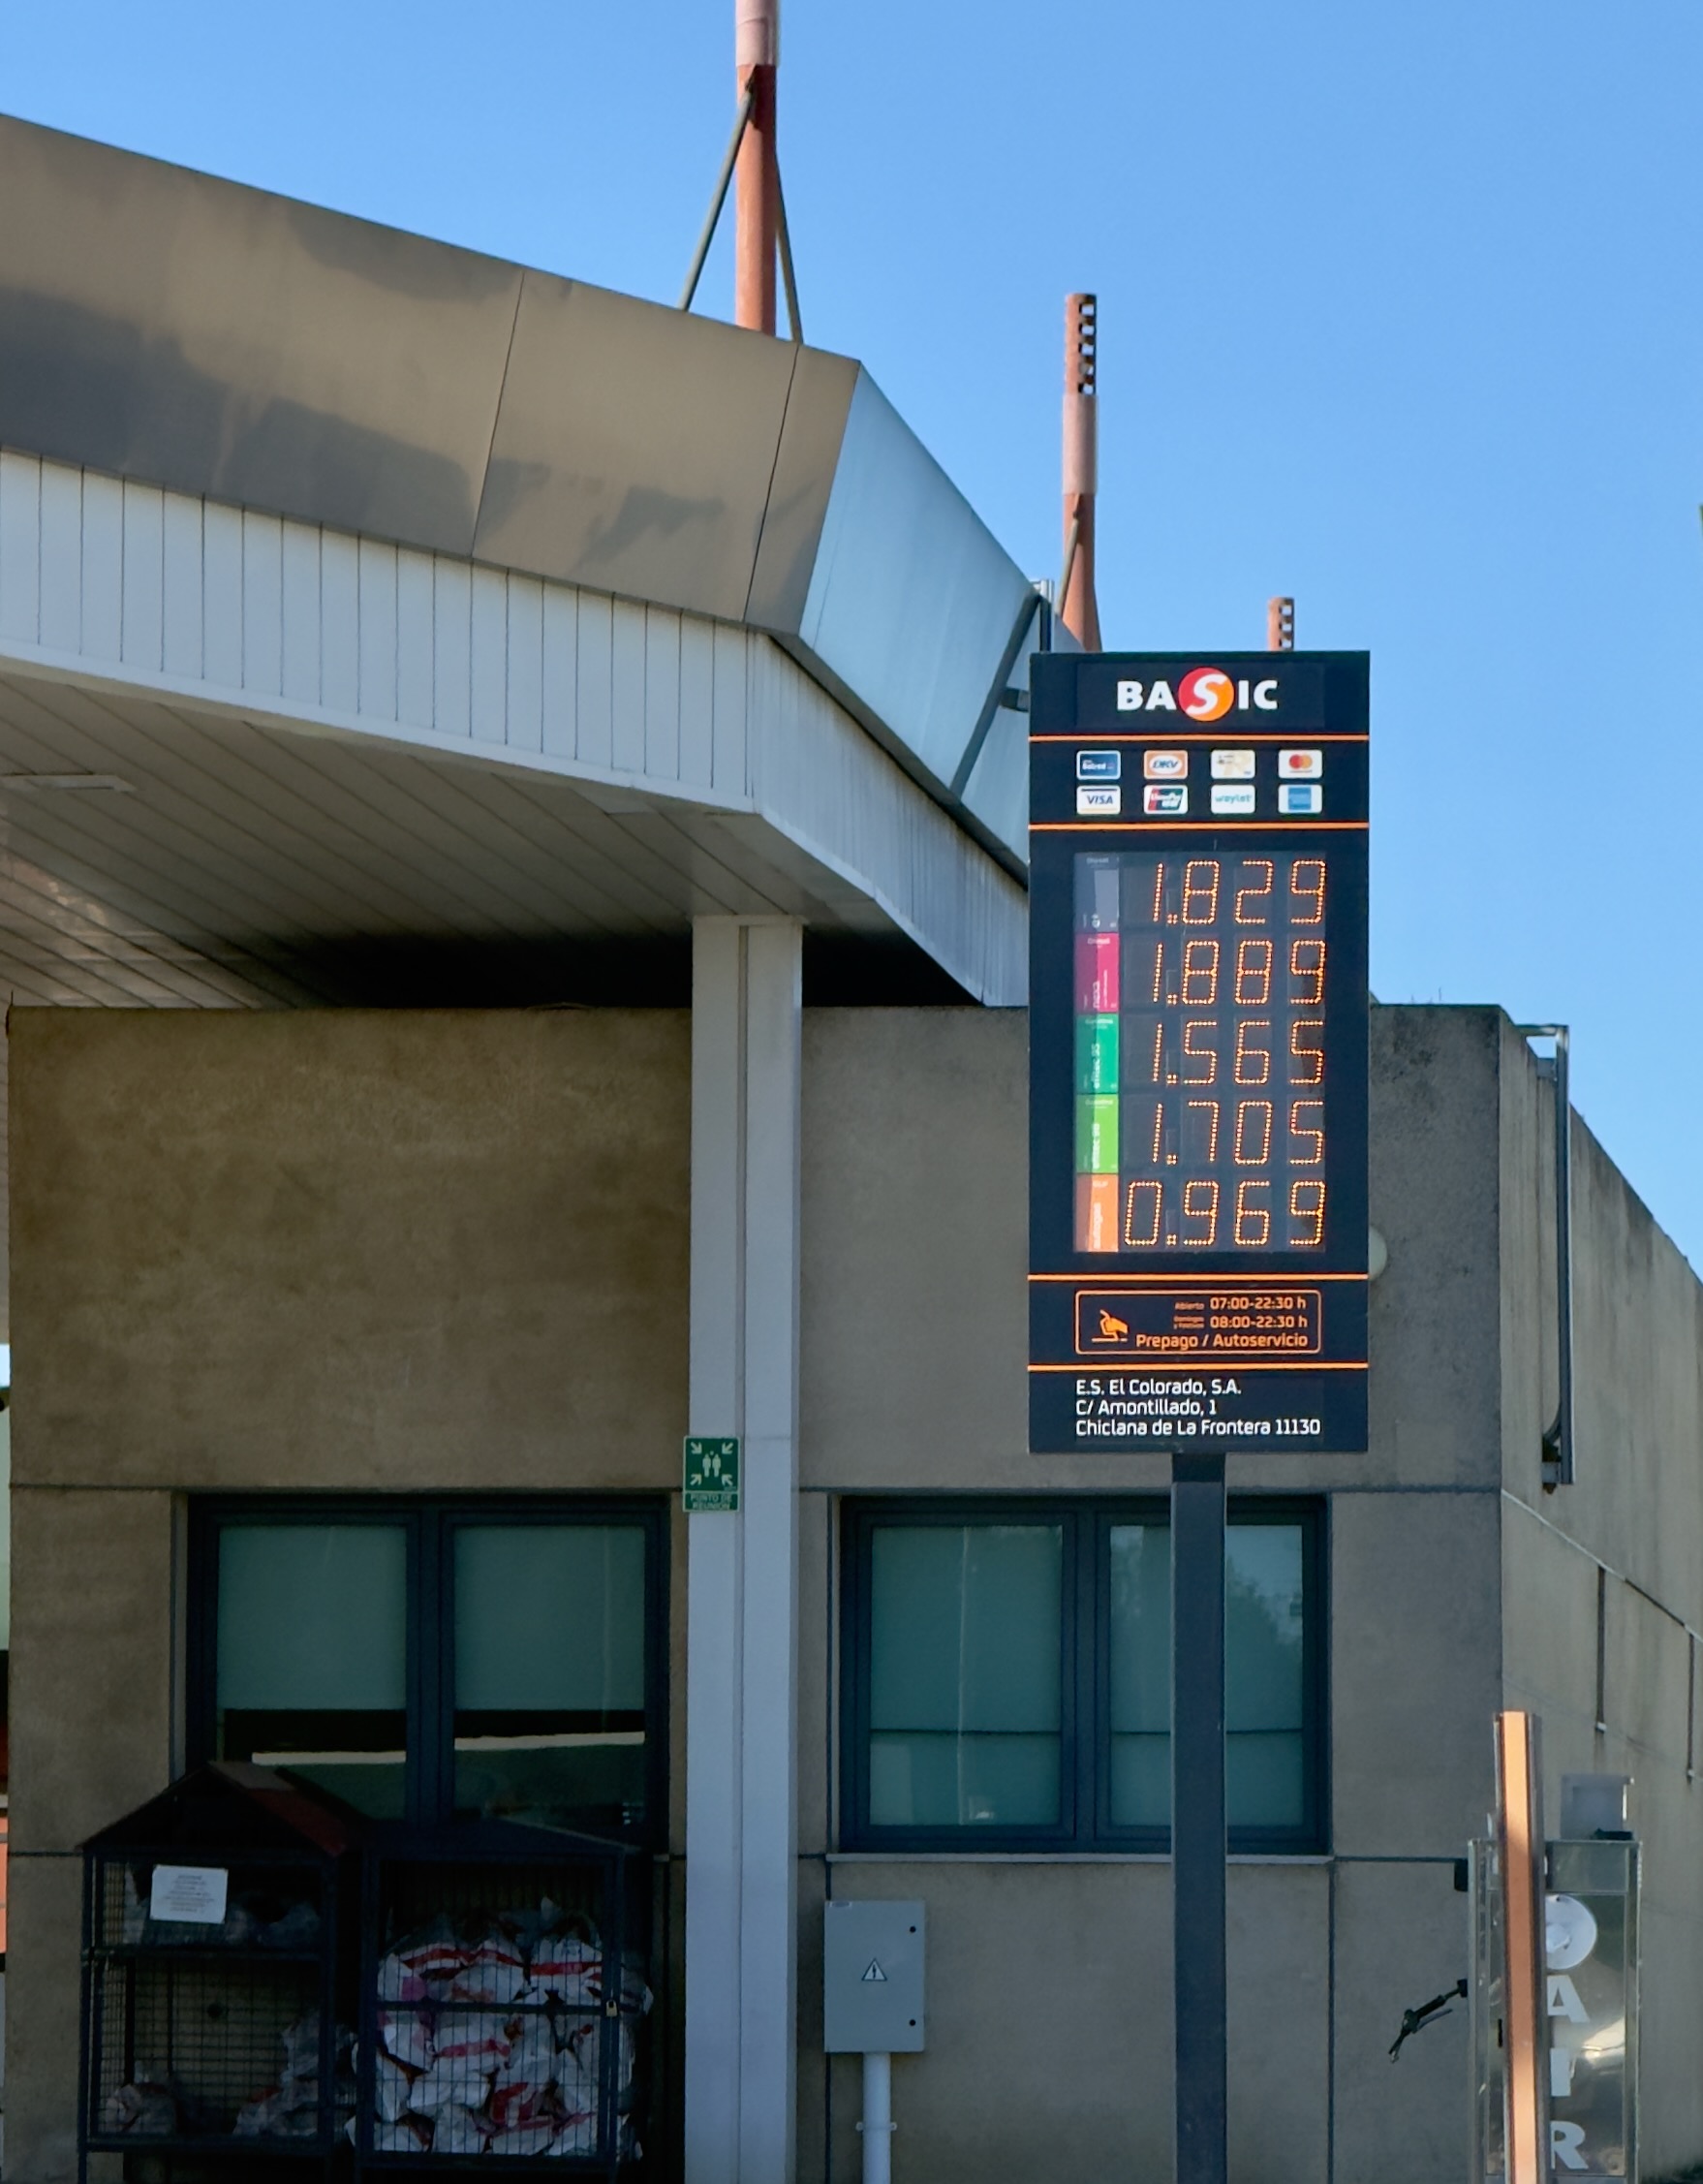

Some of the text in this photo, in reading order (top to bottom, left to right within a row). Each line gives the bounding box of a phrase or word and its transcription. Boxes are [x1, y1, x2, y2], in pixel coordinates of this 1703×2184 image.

[1116, 671, 1279, 717] BASIC
[1086, 795, 1114, 805] VISA
[1215, 794, 1253, 805] waylet
[1152, 859, 1327, 925] 1.829
[1152, 940, 1327, 1005] 1.889
[1152, 1019, 1325, 1085] 1.565
[1152, 1100, 1324, 1166] 1.705
[1123, 1179, 1327, 1246] 0.969
[1296, 1296, 1307, 1309] h
[1298, 1315, 1308, 1328] h
[1135, 1333, 1199, 1351] Prepago
[1212, 1332, 1309, 1347] Autoservicio
[1076, 1378, 1242, 1397] E.S. El Colorado, S.A.
[1075, 1398, 1217, 1417] C/ Amontillado, 1
[1075, 1419, 1321, 1436] Chiclana de La Frontera 11130
